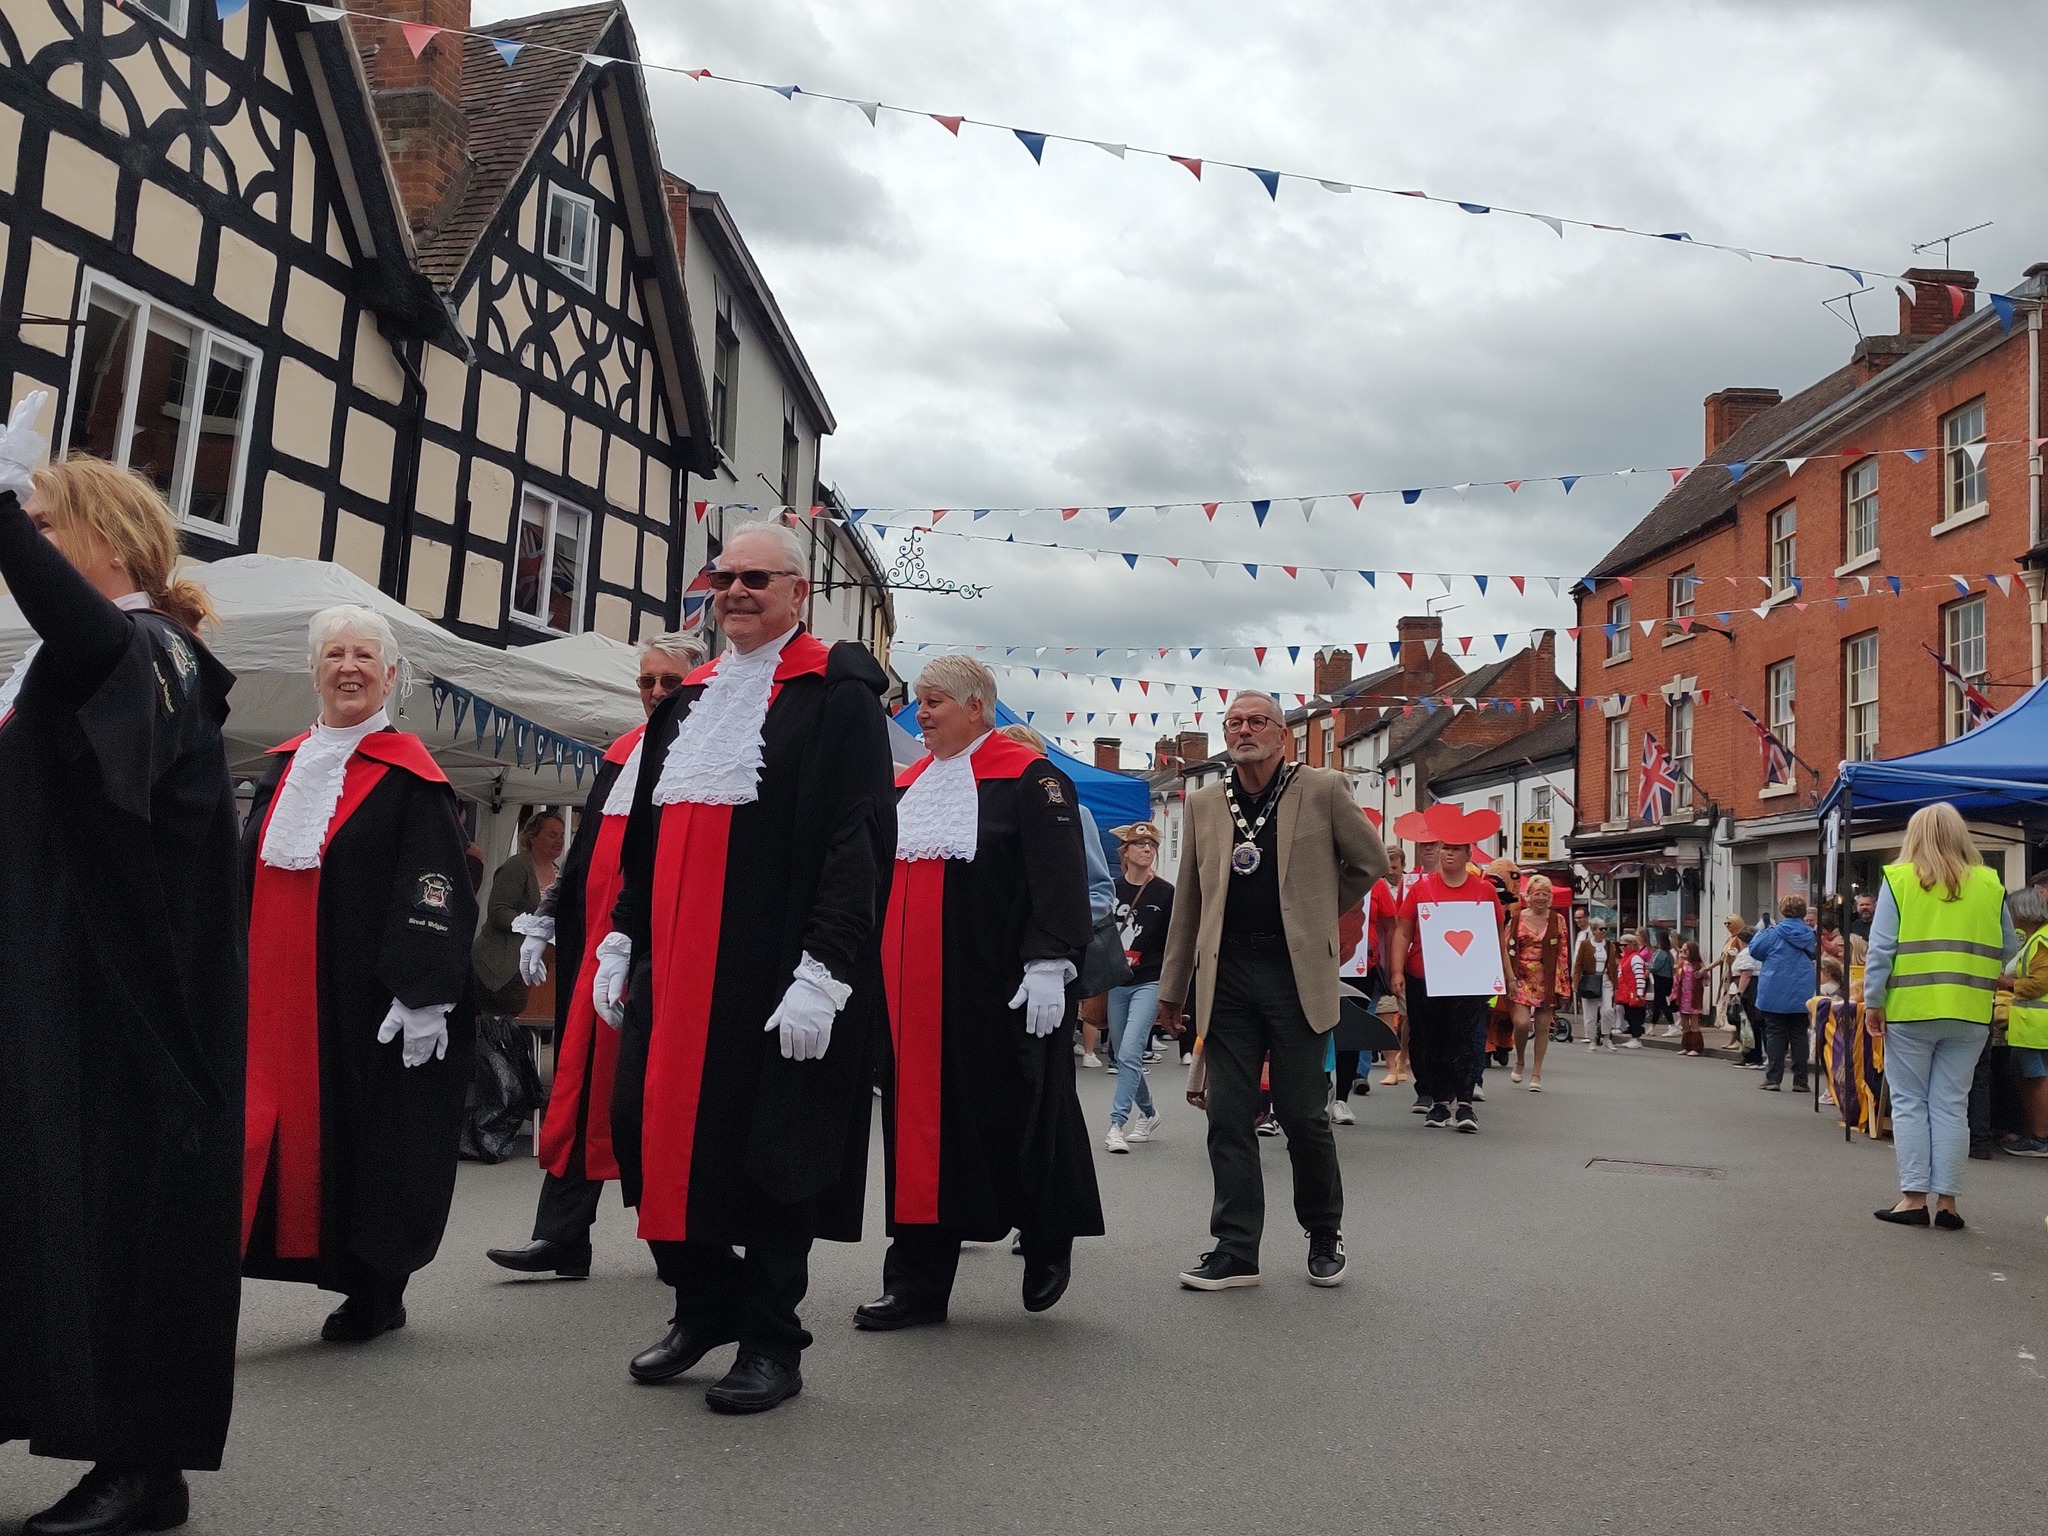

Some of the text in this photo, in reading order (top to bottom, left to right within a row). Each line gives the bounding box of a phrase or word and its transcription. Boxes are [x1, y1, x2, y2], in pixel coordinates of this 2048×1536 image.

[435, 686, 466, 719] ST
[1420, 904, 1431, 914] A
[1355, 956, 1366, 967] A
[1493, 975, 1504, 986] A
